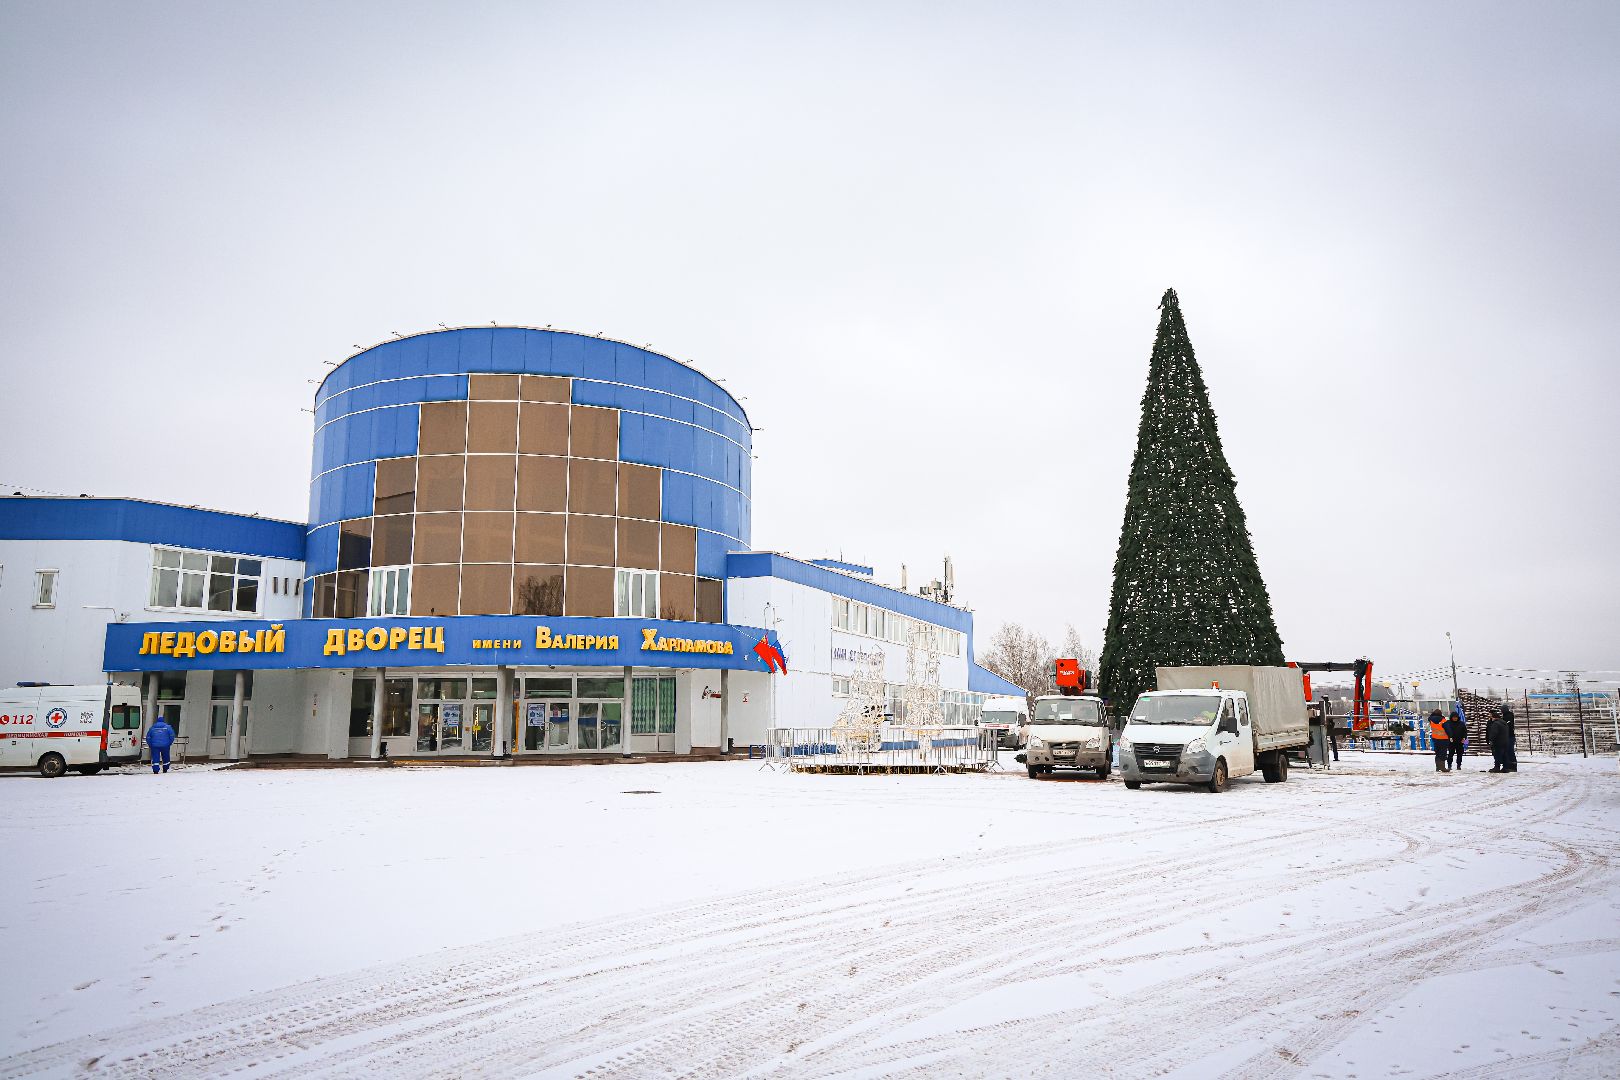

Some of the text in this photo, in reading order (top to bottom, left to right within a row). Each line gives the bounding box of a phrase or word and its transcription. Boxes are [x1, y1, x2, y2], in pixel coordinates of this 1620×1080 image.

[139, 624, 286, 658] ЛЕДОВЫЙ
[324, 626, 445, 656] ДВОРЕЦ
[472, 639, 522, 649] ИМЕНИ
[12, 714, 33, 725] 112
